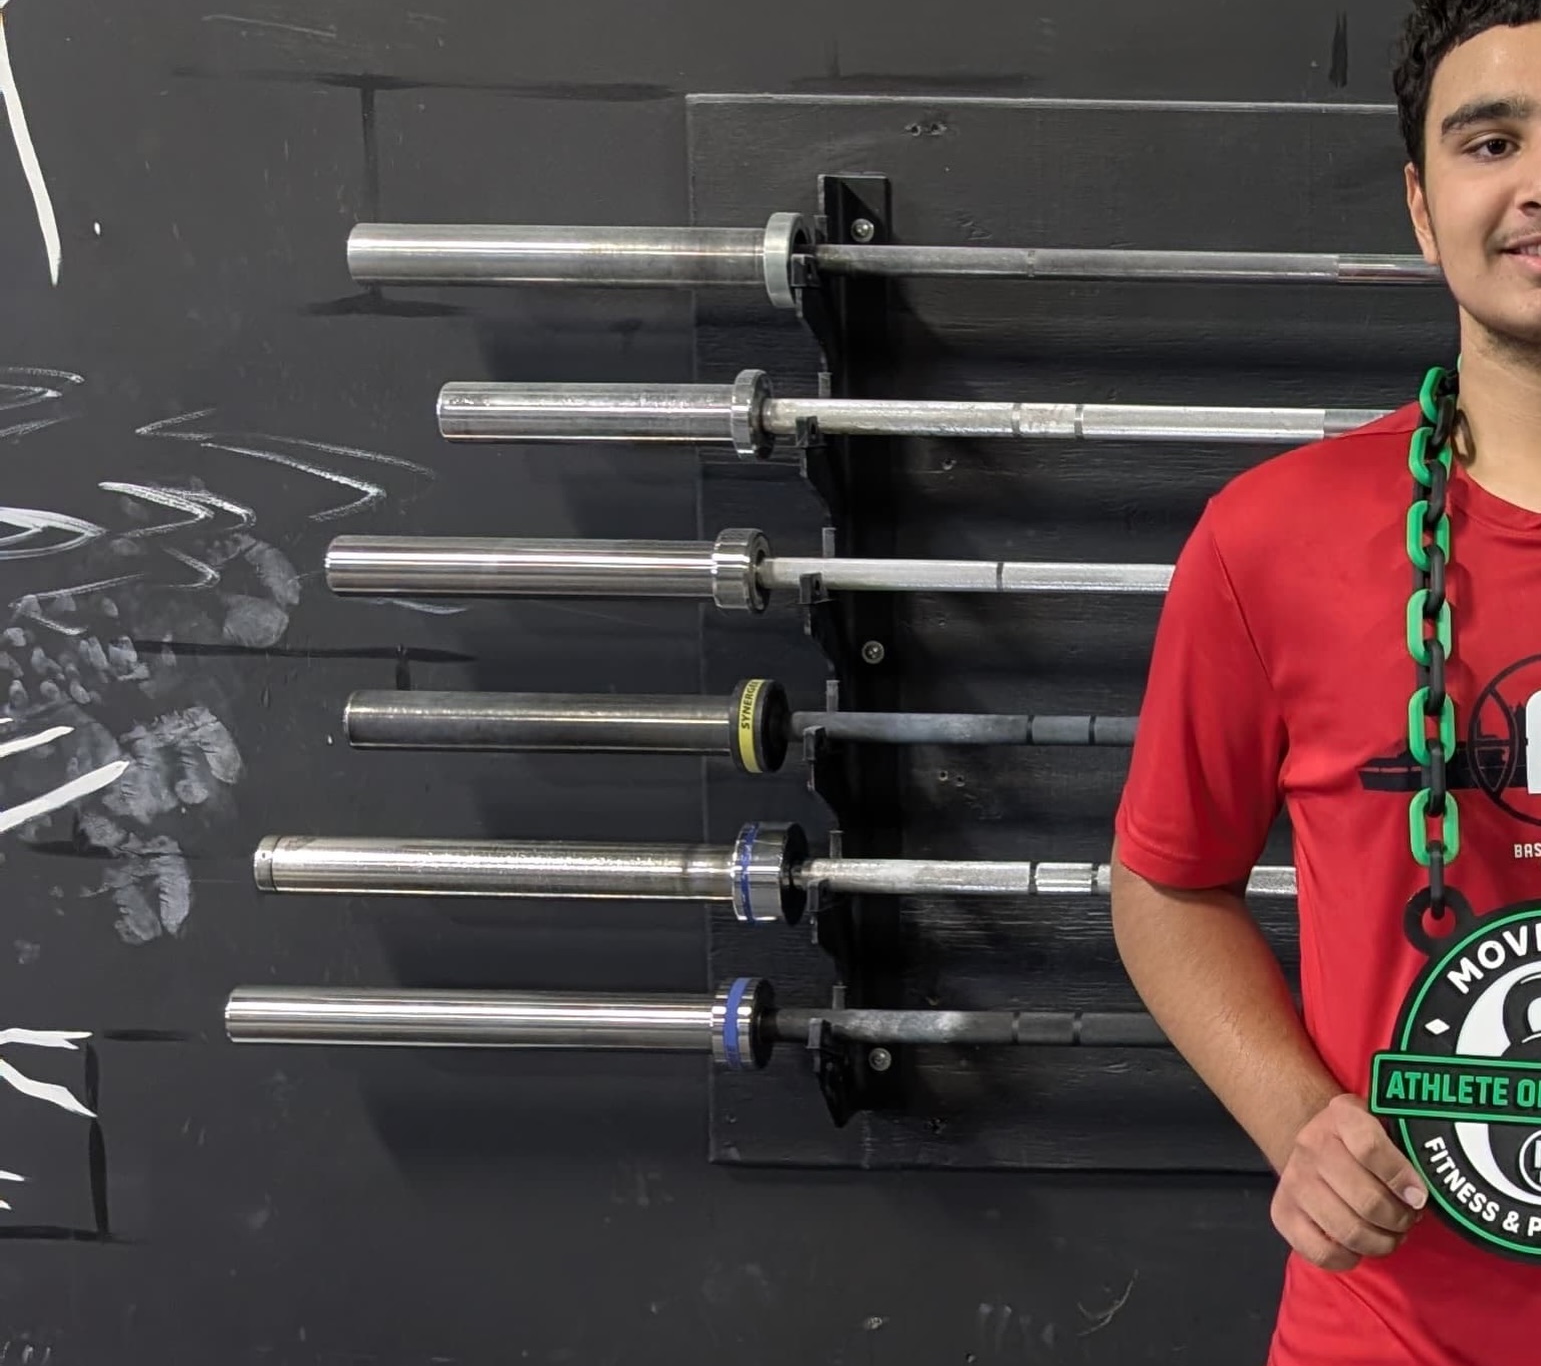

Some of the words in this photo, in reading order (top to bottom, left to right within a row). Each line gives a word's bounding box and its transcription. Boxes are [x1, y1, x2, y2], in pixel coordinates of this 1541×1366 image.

[1386, 1070, 1511, 1106] ATHLETE
[1424, 1136, 1499, 1223] FITNESS
[1502, 1210, 1520, 1235] &
